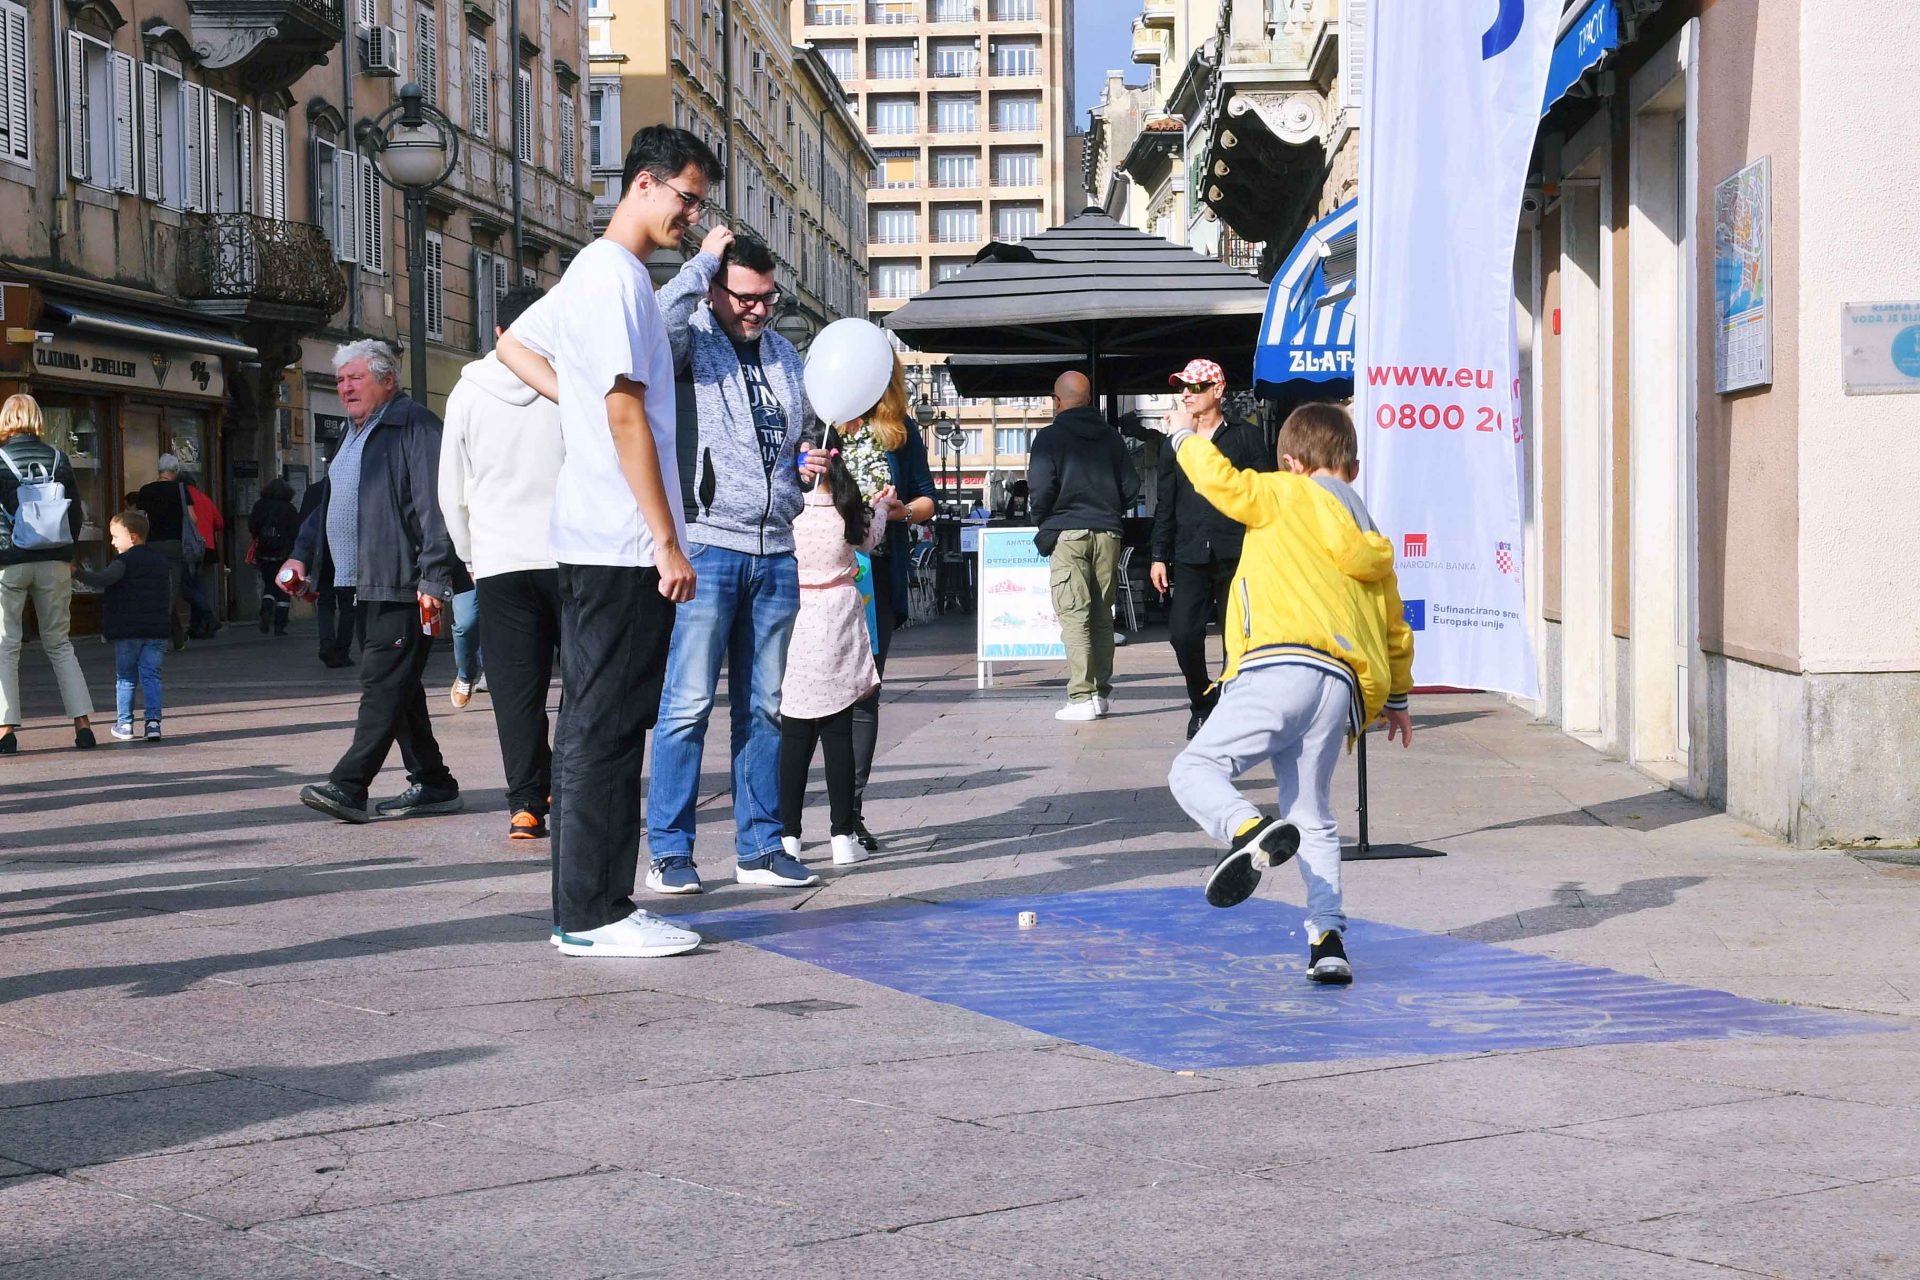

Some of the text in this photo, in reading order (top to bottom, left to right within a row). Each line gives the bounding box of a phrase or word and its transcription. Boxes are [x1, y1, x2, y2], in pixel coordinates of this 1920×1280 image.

[91, 357, 136, 378] JEWELLERY
[1288, 350, 1355, 372] ZLAT
[1376, 403, 1502, 432] 0800 2
[1400, 560, 1476, 571] NARODNA BANKA
[1433, 603, 1500, 617] Sufinancirano
[1432, 615, 1505, 631] Europske unije
